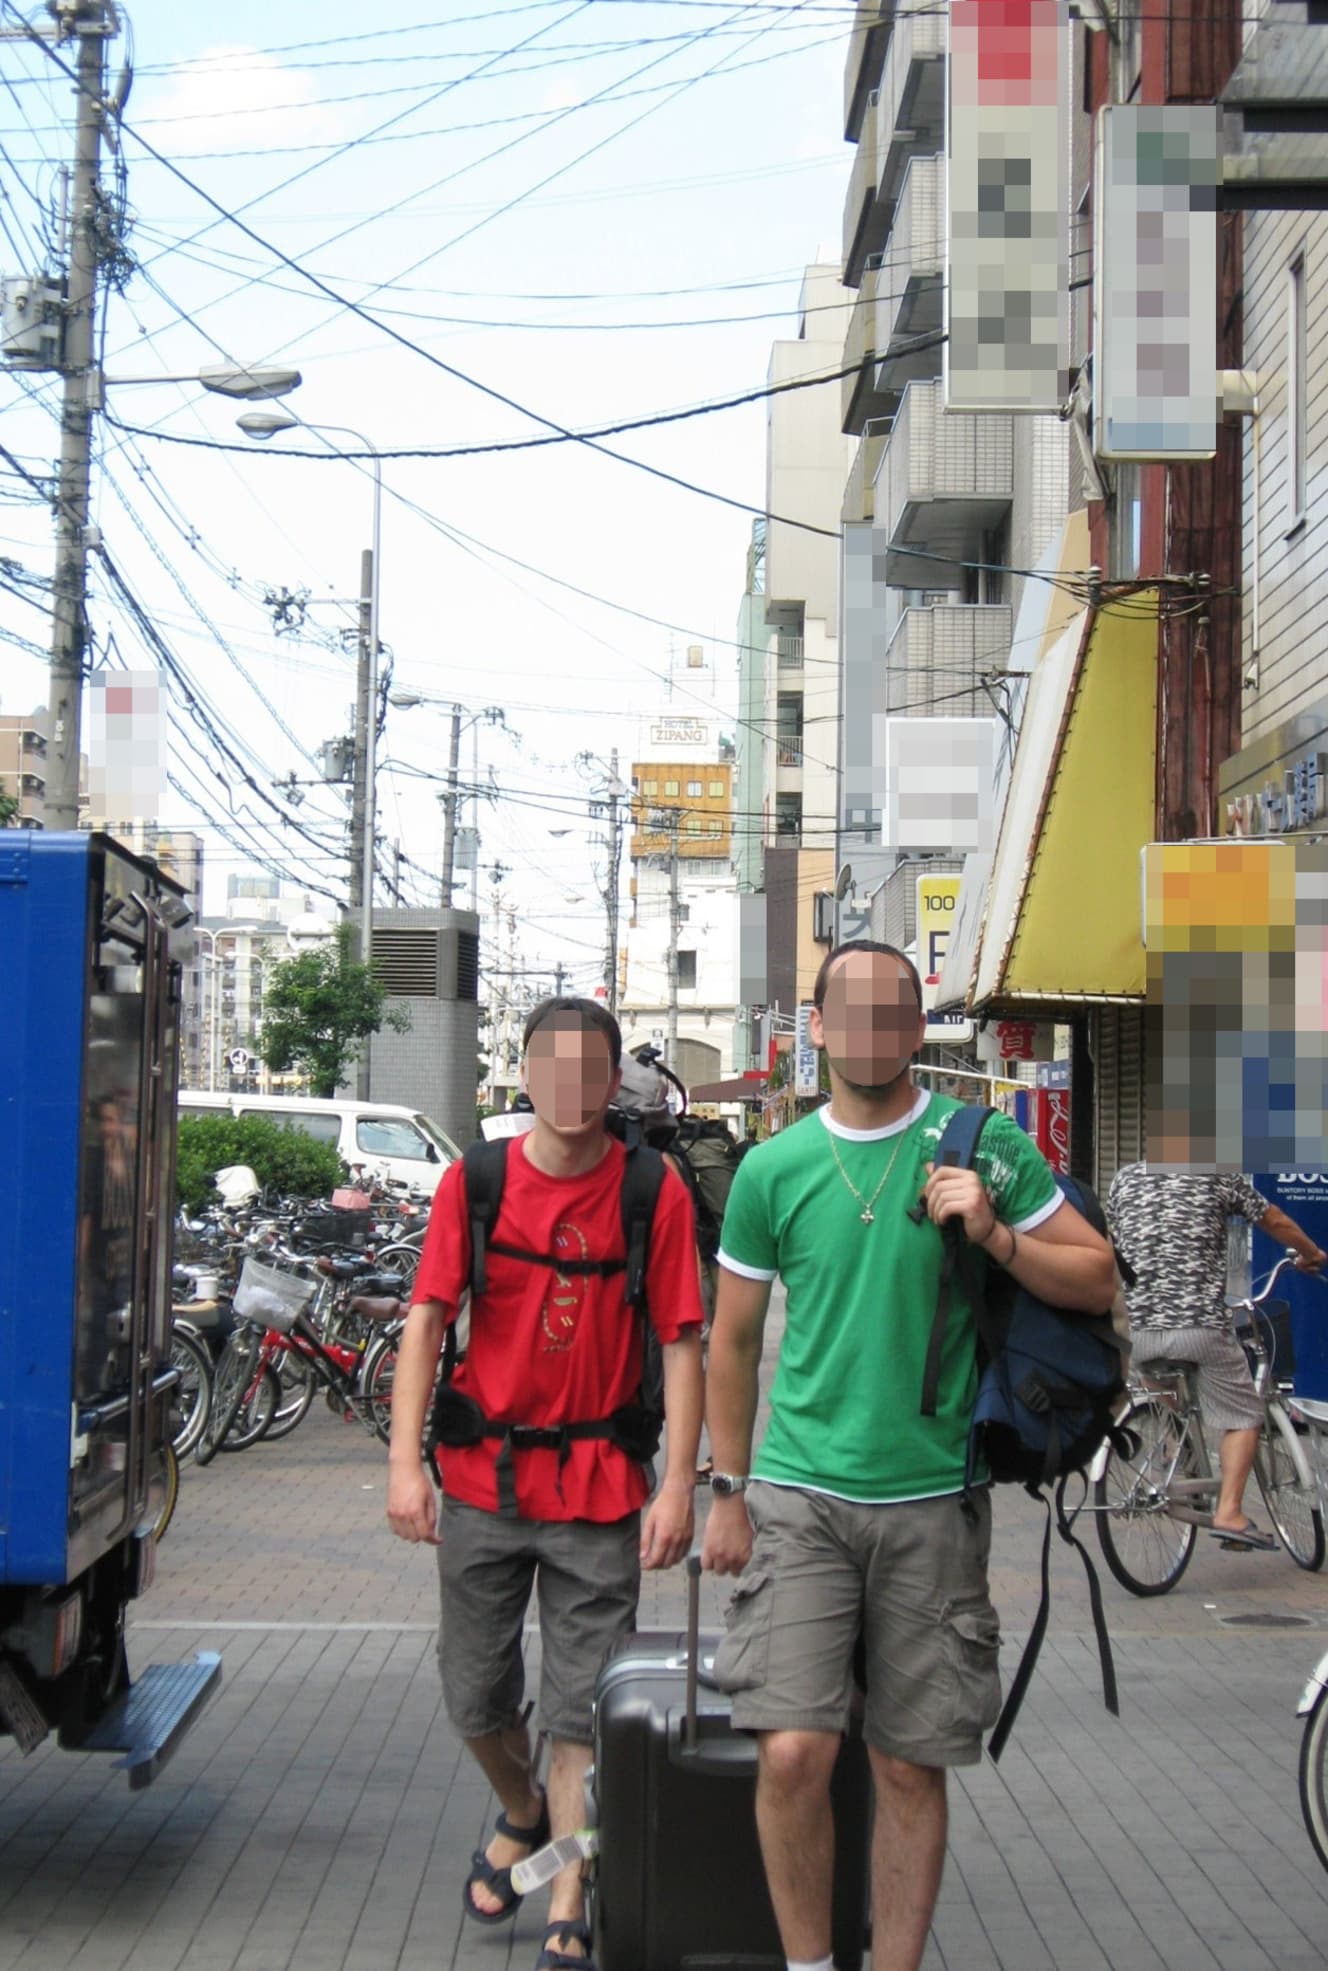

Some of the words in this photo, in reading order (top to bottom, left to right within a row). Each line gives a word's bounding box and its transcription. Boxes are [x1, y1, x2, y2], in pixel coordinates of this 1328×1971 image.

[664, 720, 693, 728] HOTEL
[656, 730, 702, 741] ZIPANG
[924, 895, 955, 911] 100
